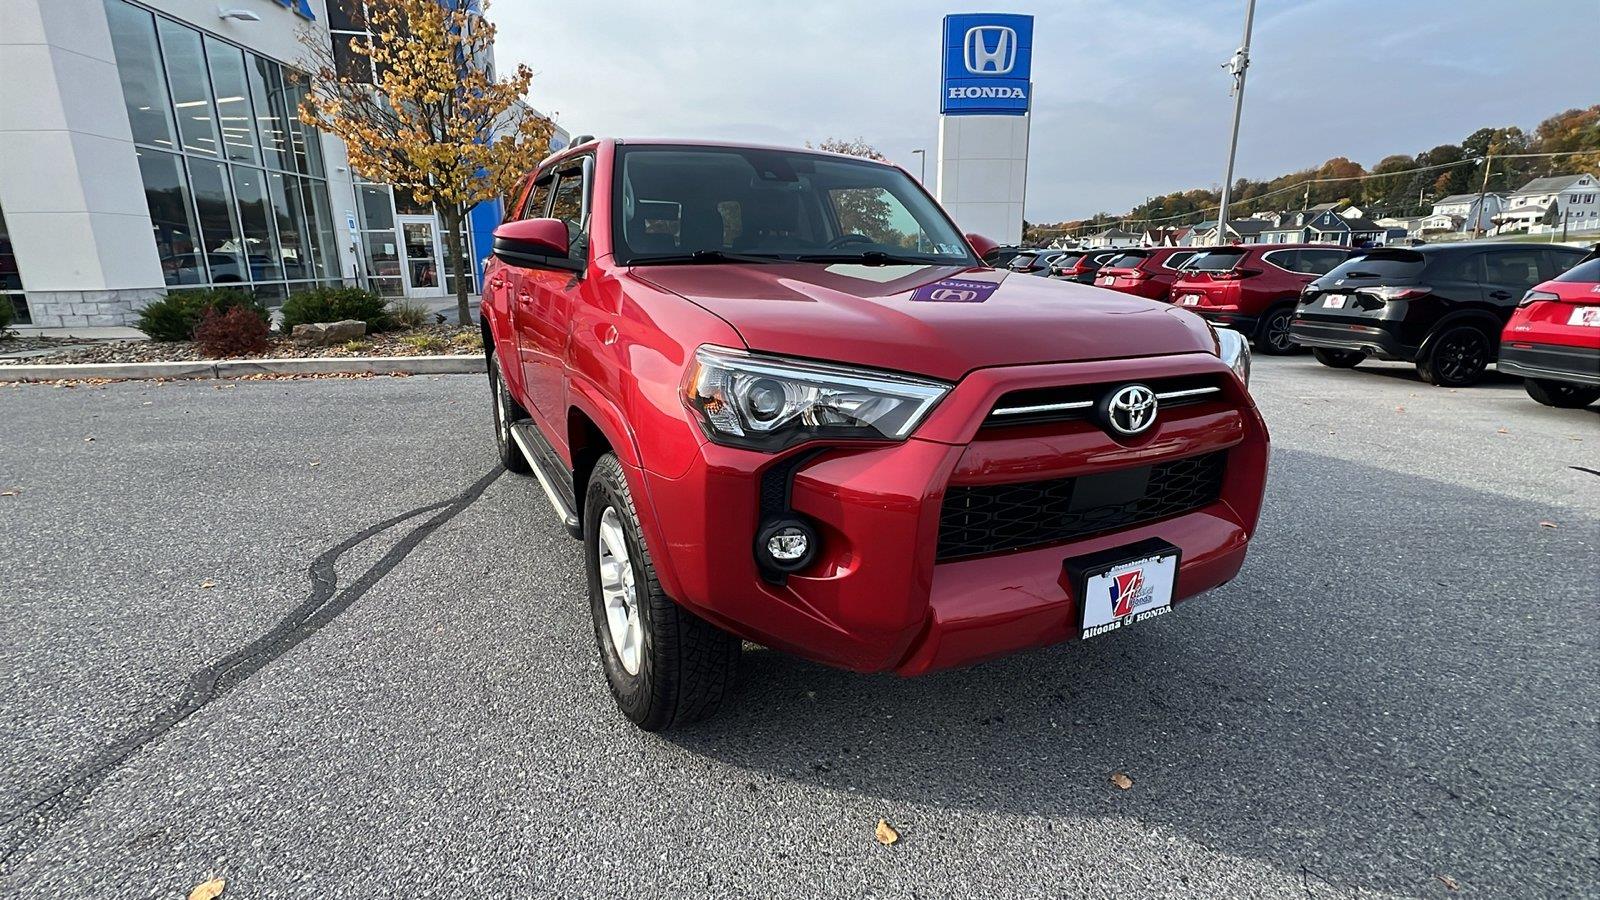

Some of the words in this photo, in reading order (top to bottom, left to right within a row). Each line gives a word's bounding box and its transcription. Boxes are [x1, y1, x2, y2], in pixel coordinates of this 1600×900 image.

[948, 87, 1026, 99] HONDA
[1082, 620, 1121, 640] Altoona
[1136, 605, 1173, 622] HONDA
